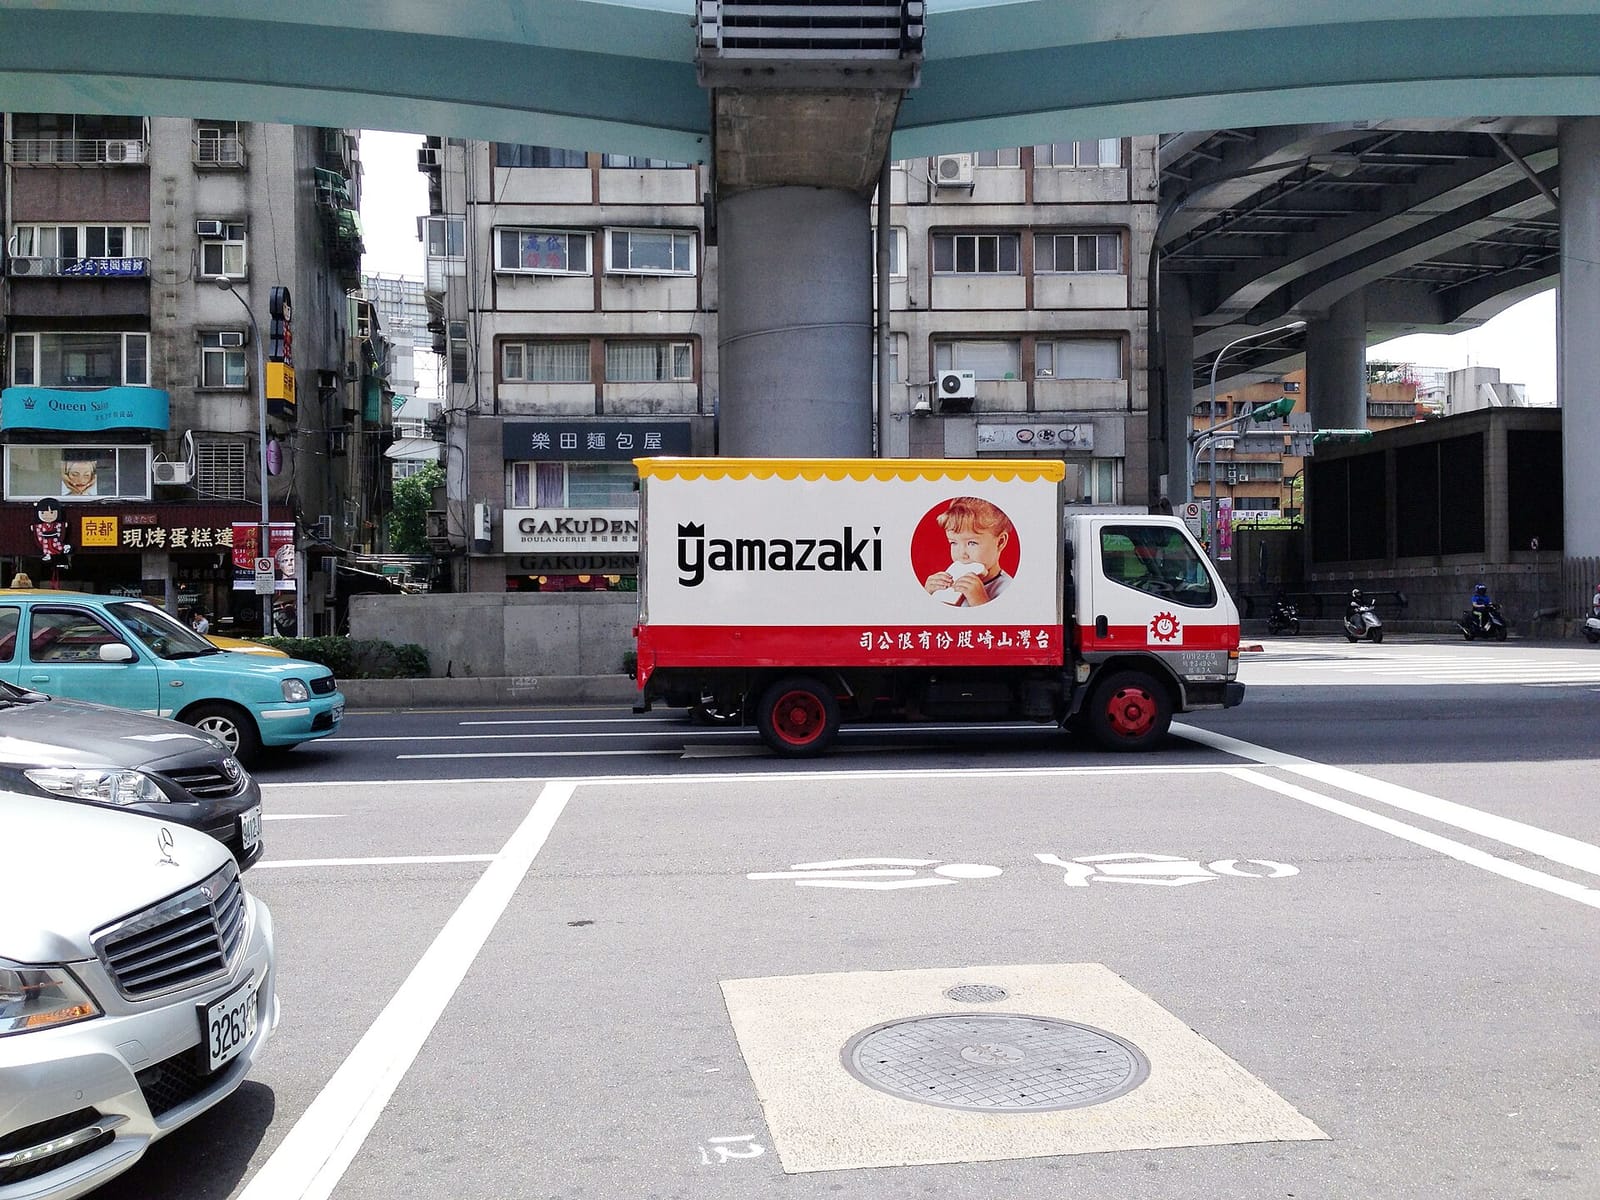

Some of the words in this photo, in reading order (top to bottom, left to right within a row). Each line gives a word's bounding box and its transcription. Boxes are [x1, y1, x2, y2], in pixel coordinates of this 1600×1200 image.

[48, 399, 87, 412] Queen
[531, 431, 663, 450] 樂田麵包屋
[85, 520, 113, 536] 京都
[677, 521, 882, 587] yamazaki
